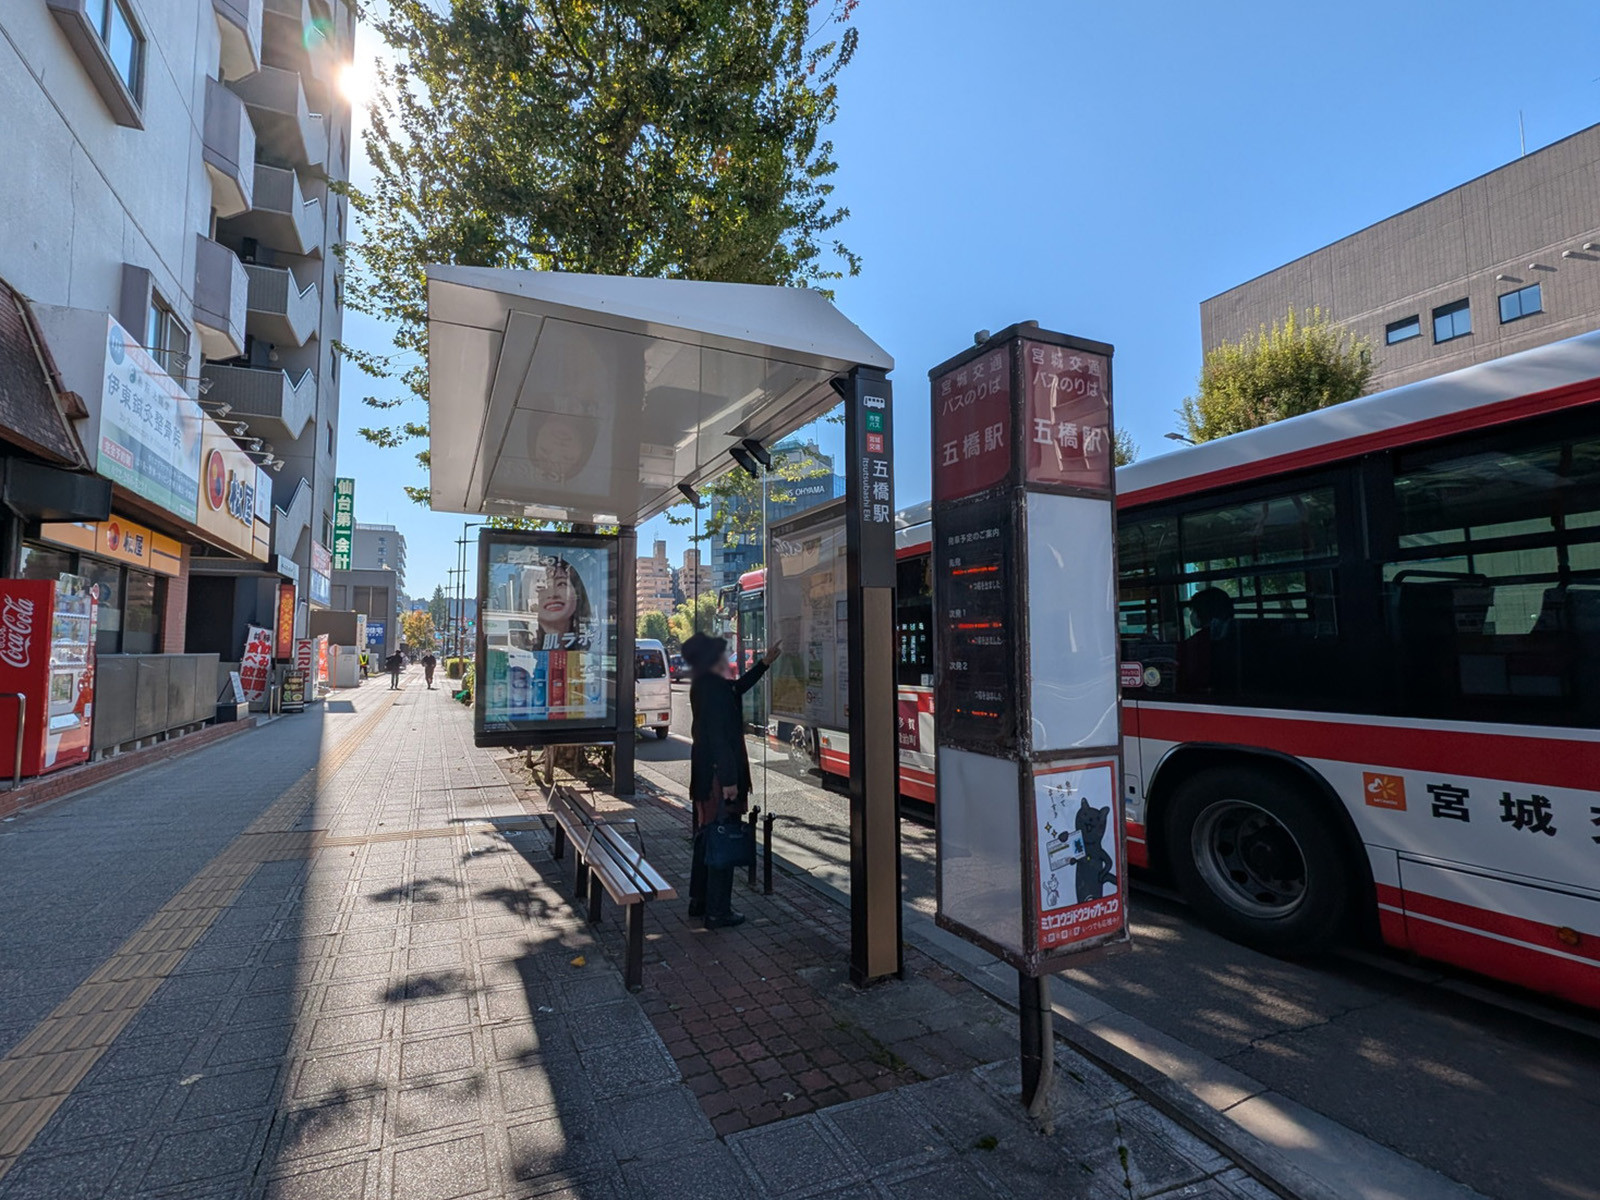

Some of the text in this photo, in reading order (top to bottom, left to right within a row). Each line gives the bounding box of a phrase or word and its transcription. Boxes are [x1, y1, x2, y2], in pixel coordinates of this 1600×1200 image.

[941, 353, 1003, 397] 宮城交通
[1032, 347, 1101, 377] 宮城交通
[942, 377, 1001, 416] バスのりば
[1033, 371, 1099, 397] バスのりば
[943, 422, 1004, 467] 五橋駅
[1033, 417, 1102, 453] 五橋駅
[795, 485, 825, 496] OHYAMA
[862, 457, 871, 522] Itsutsubashi Eki
[872, 459, 890, 523] 五橋駅
[334, 479, 353, 570] 仙台第一会計
